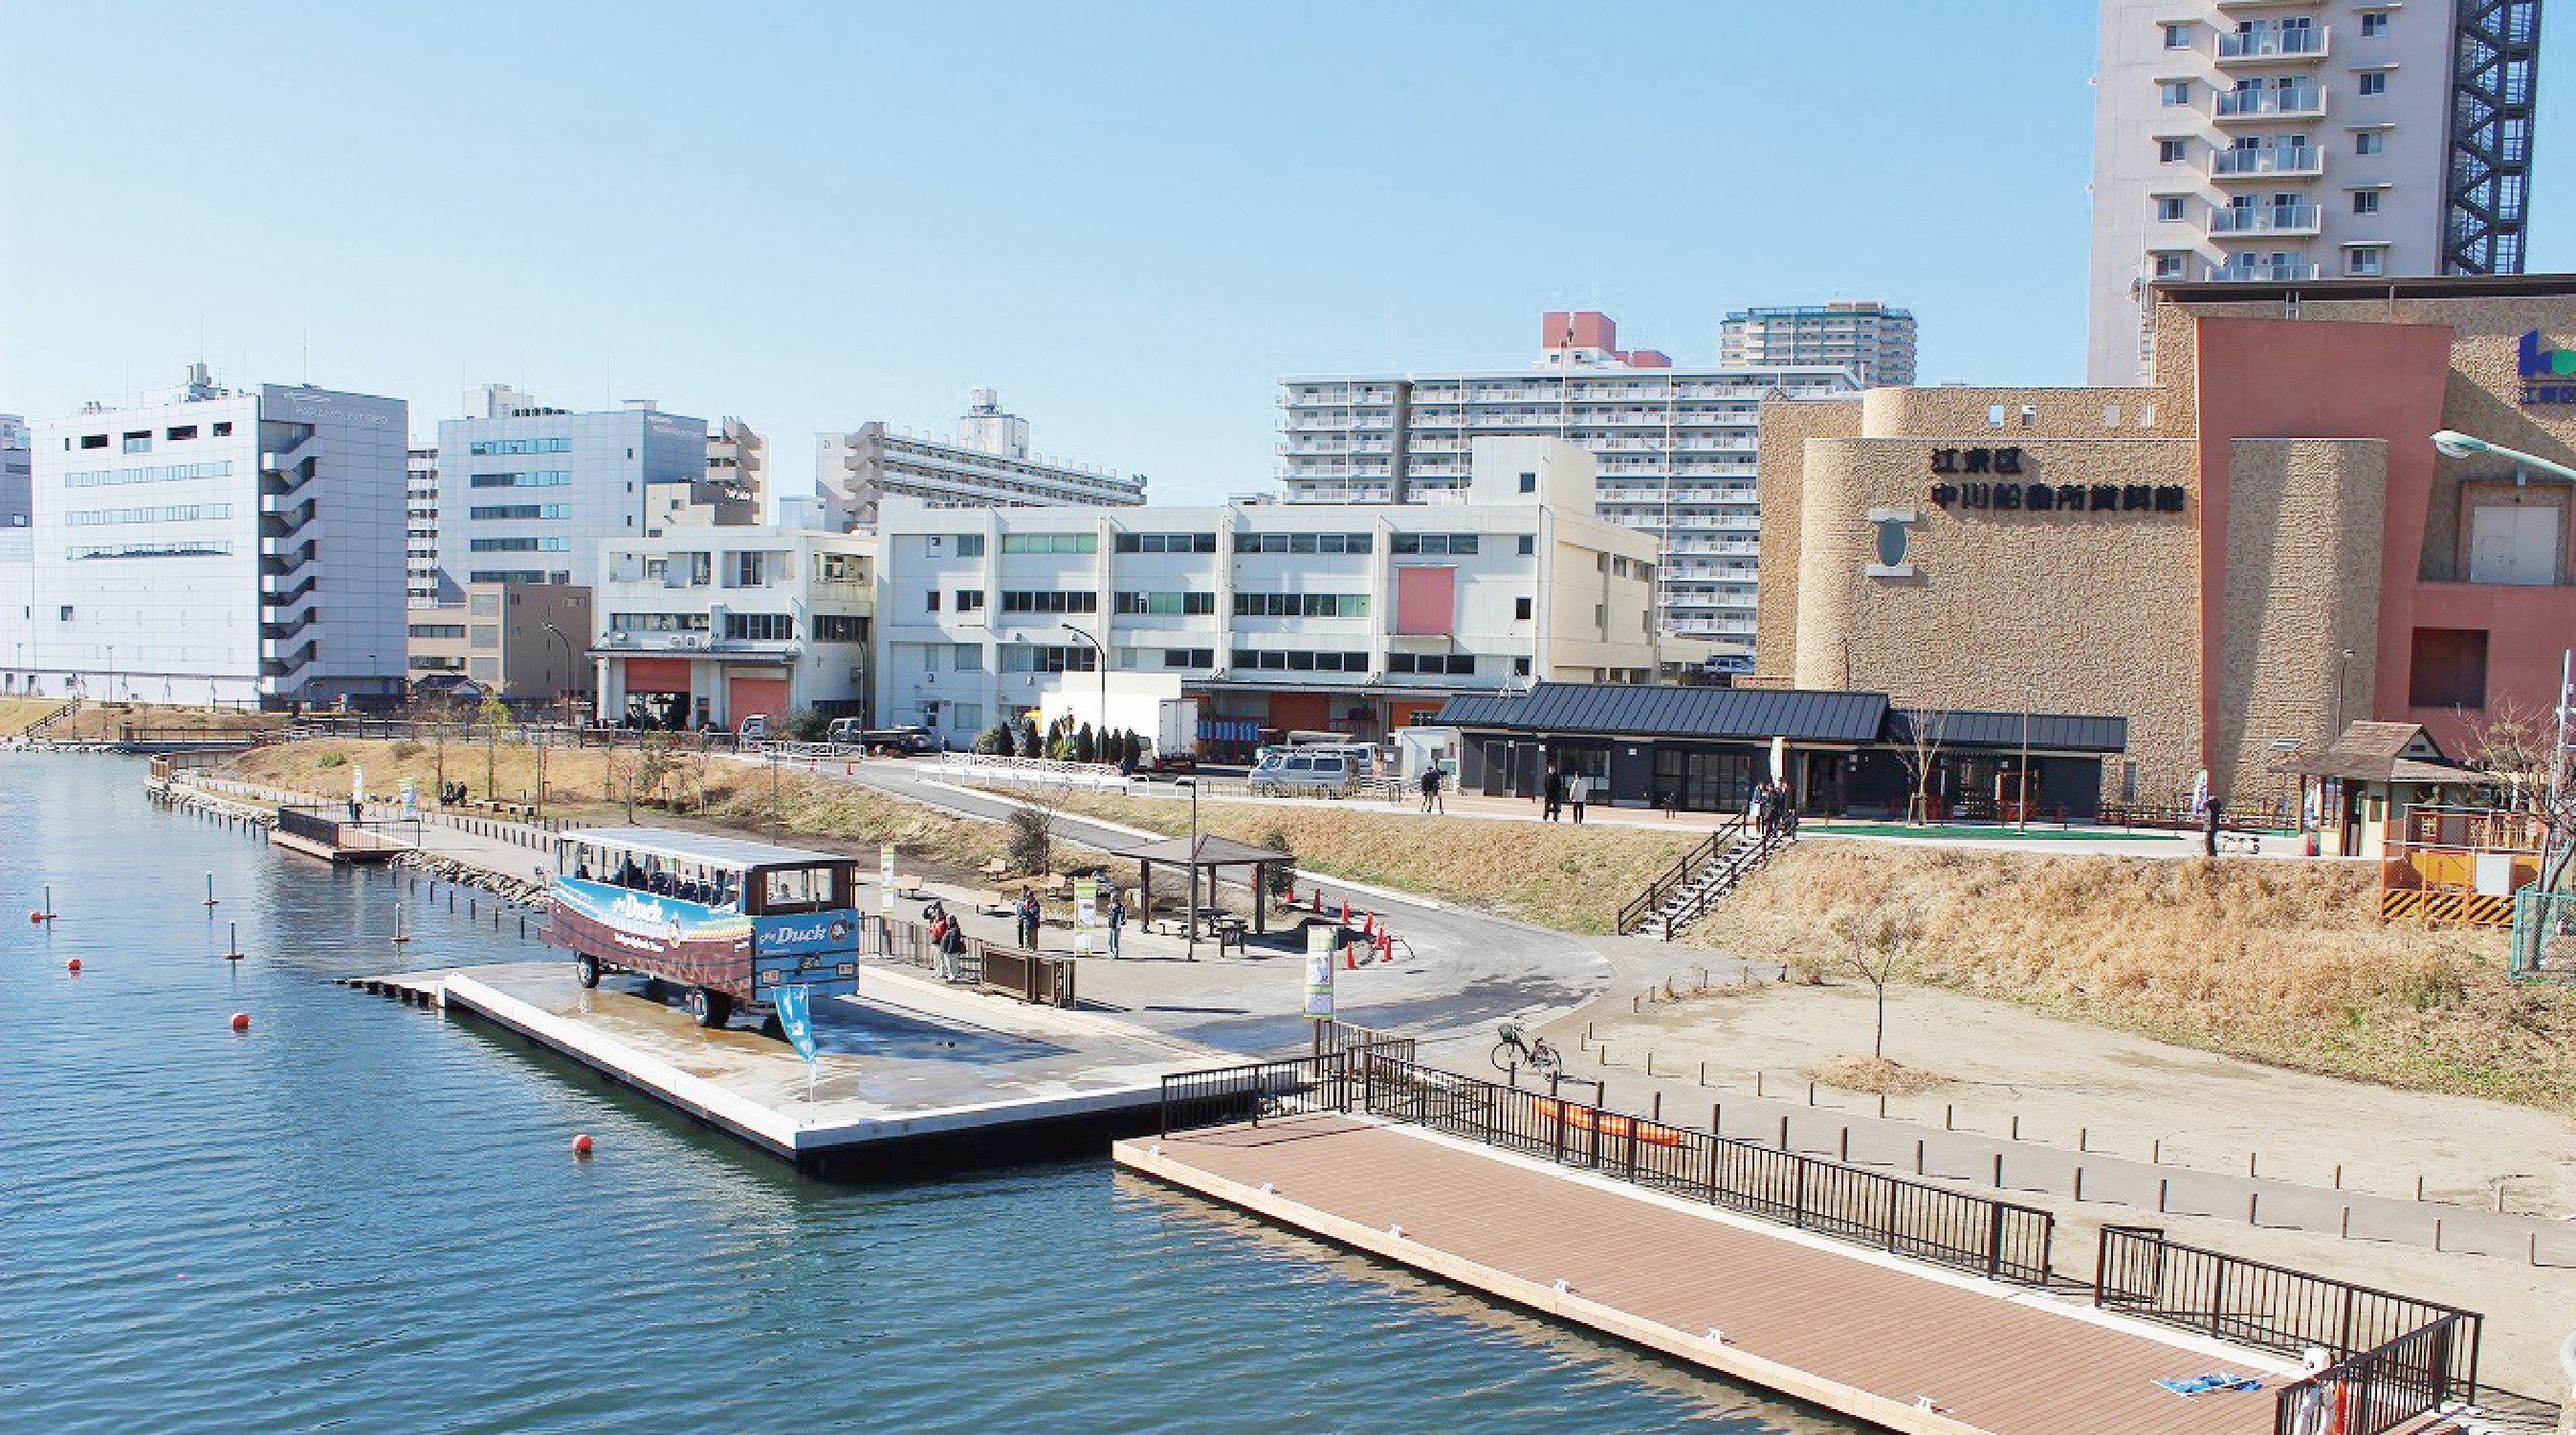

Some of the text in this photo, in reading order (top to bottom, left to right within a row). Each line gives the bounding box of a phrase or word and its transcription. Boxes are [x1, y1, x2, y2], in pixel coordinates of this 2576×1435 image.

[1931, 447, 2023, 475] 江東区
[776, 923, 827, 945] Duck
